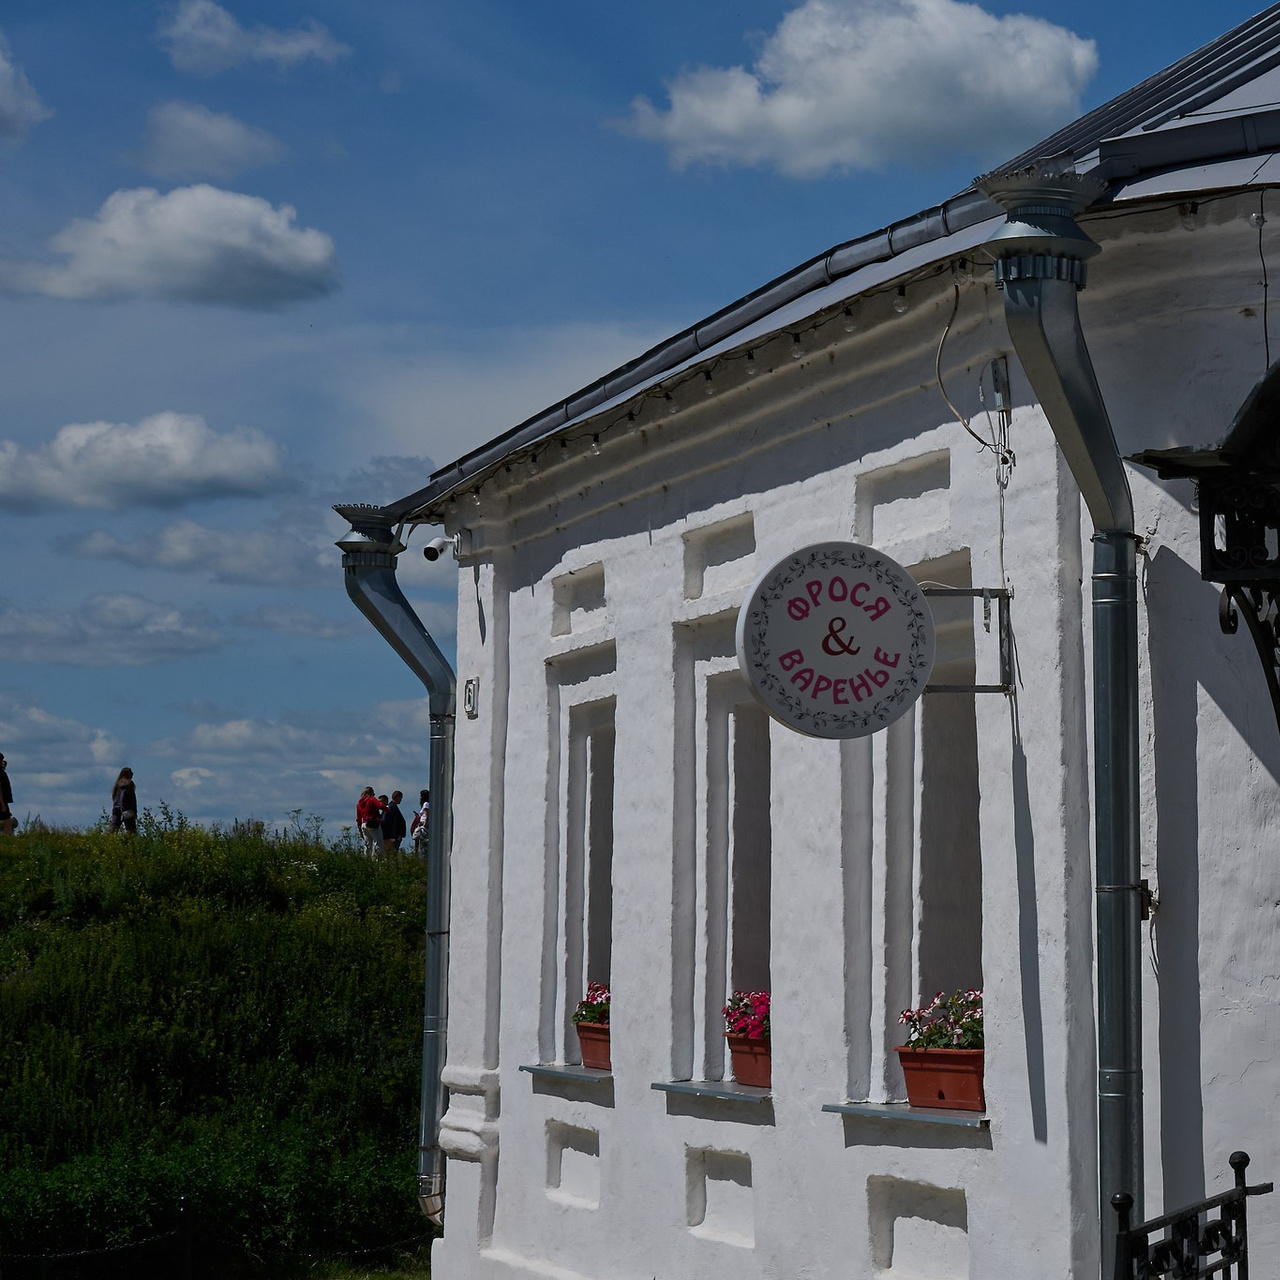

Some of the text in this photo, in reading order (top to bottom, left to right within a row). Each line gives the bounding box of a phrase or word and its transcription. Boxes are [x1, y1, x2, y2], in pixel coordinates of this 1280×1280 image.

[786, 576, 892, 622] ФРОСЯ
[821, 616, 861, 656] &
[778, 646, 901, 705] ВАРЕНЬЕ
